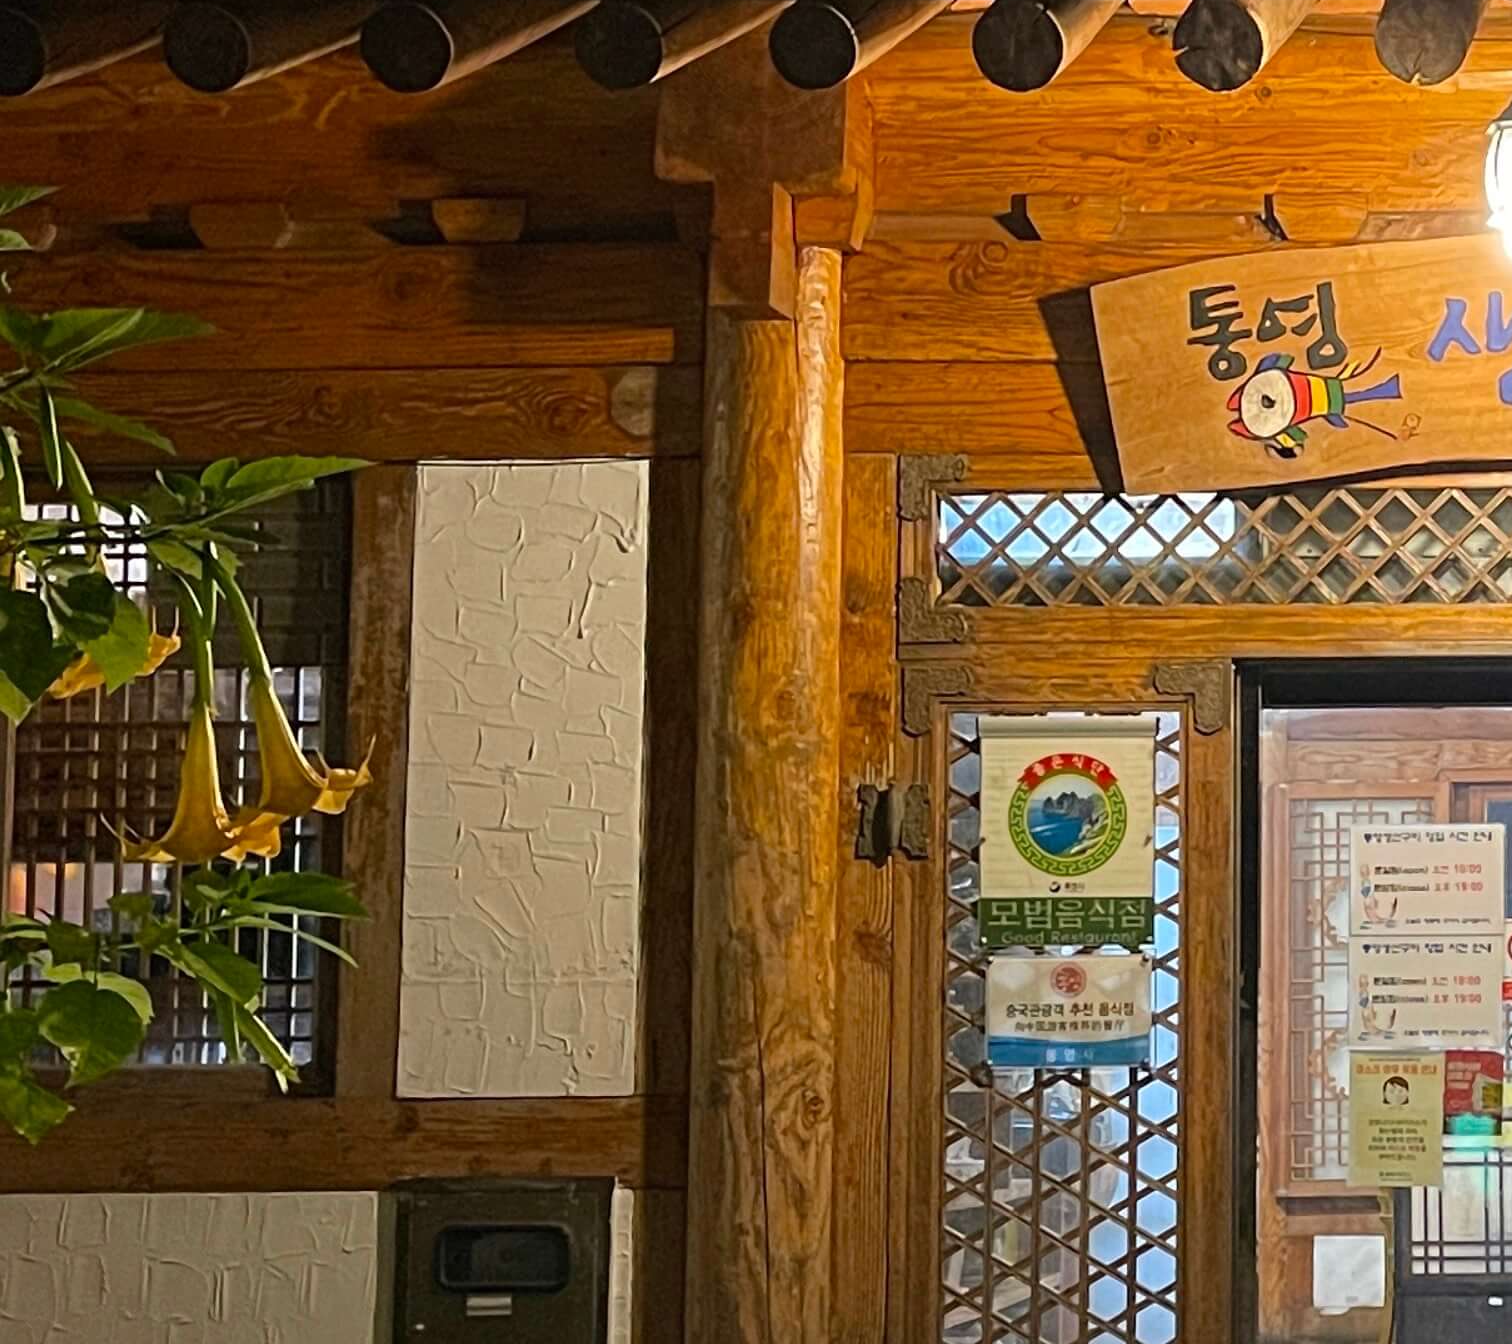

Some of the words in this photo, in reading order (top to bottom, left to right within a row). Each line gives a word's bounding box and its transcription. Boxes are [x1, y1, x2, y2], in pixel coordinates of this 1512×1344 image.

[1186, 280, 1349, 381] 통영
[986, 898, 1146, 930] 모범음식점
[1001, 930, 1045, 945] Good
